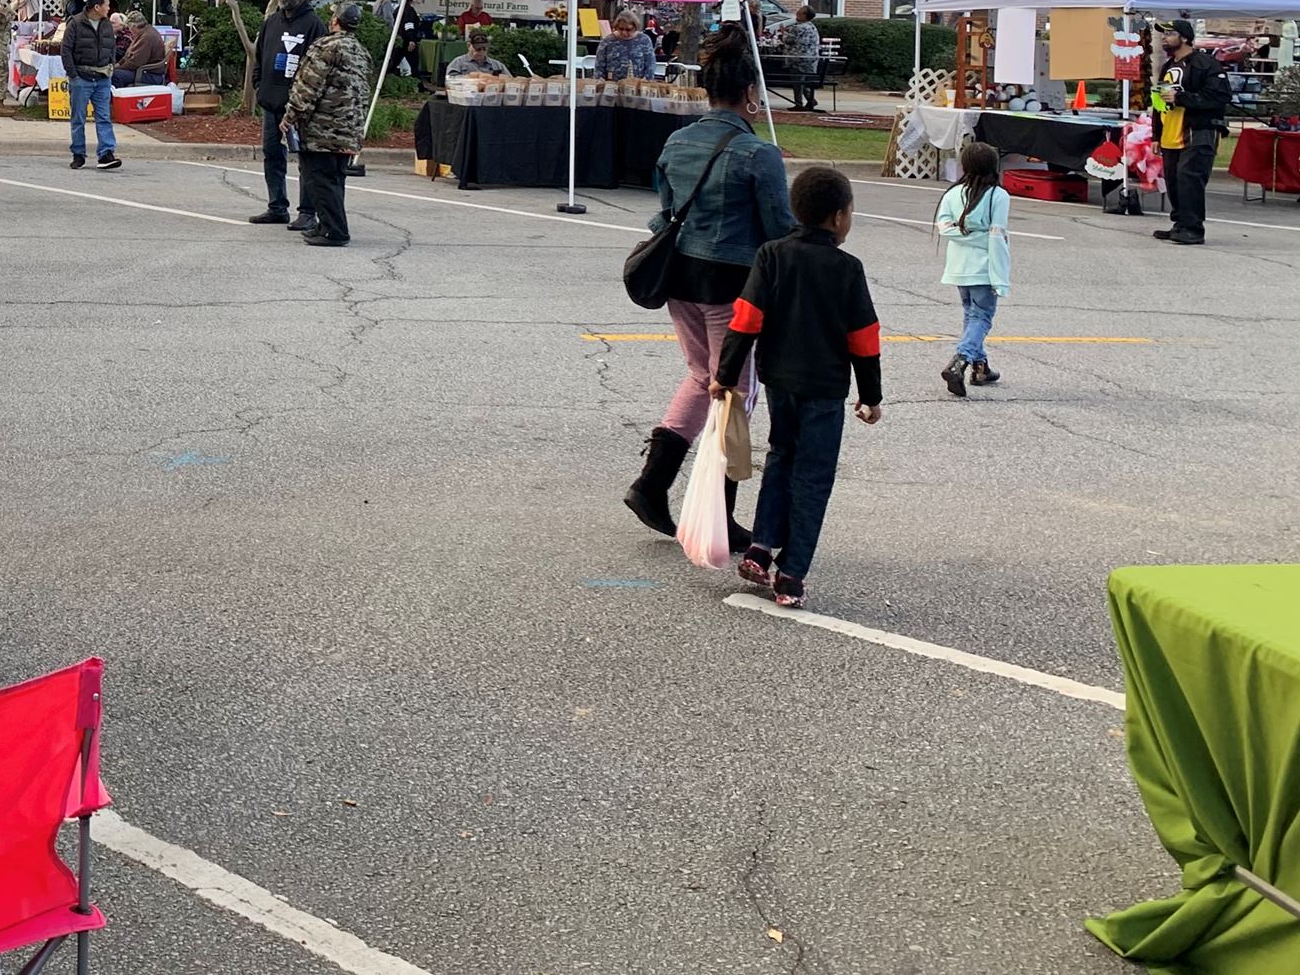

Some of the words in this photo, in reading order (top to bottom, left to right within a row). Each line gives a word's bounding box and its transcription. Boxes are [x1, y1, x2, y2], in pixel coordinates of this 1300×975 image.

[439, 0, 470, 9] Liberty
[507, 1, 529, 10] Farm
[52, 109, 70, 117] FOR
